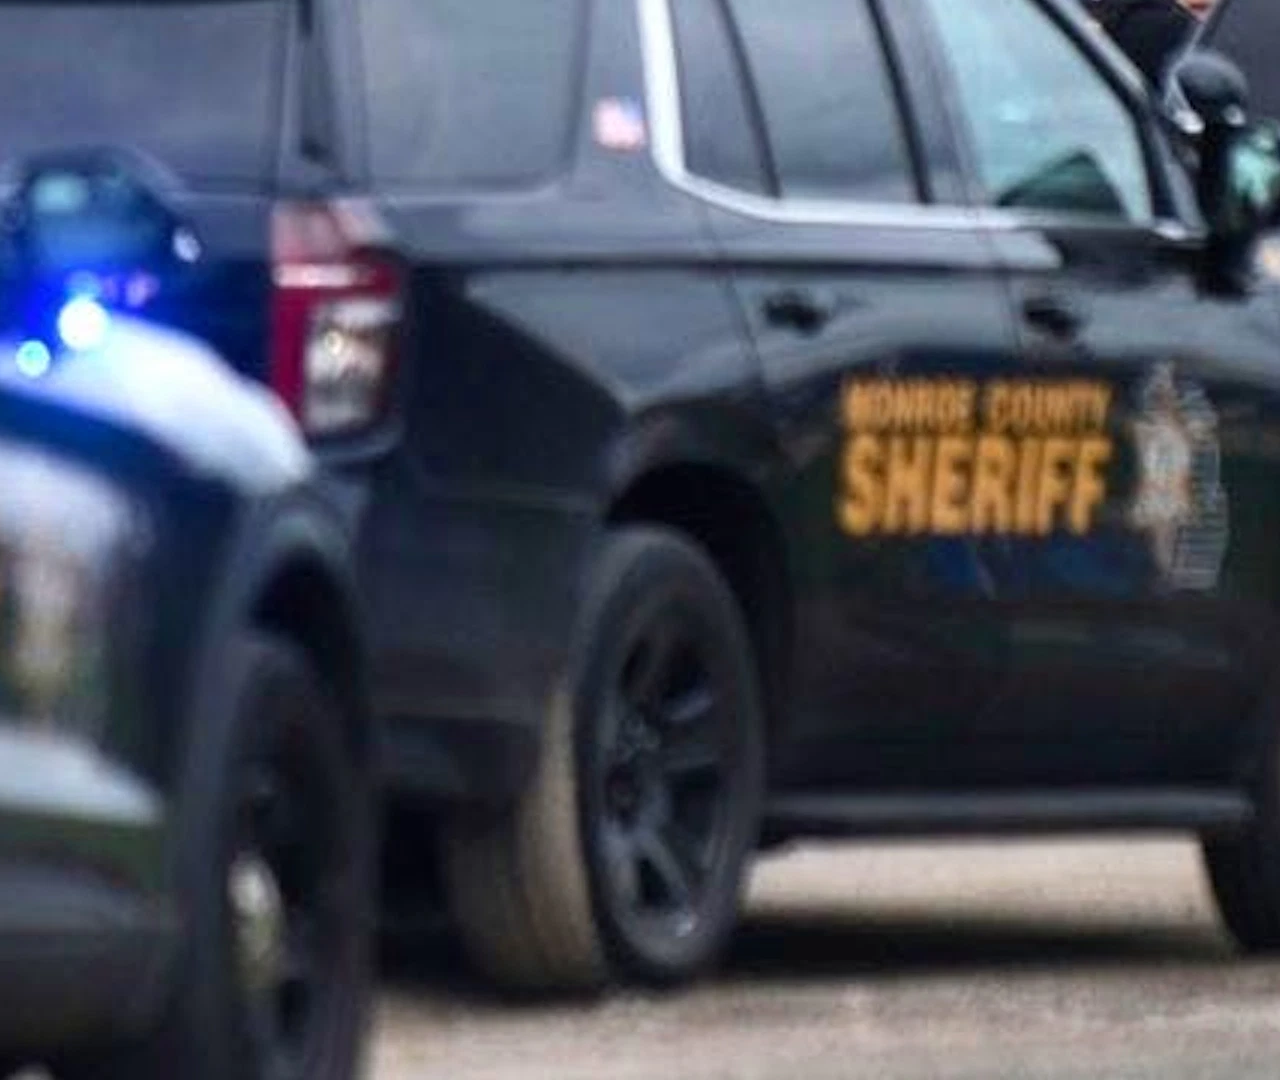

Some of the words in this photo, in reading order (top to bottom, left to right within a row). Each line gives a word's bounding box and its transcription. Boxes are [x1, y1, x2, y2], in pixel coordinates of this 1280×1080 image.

[844, 379, 975, 429] MONROE
[987, 381, 1113, 431] COUNTY
[839, 435, 1113, 536] SHERIFF
